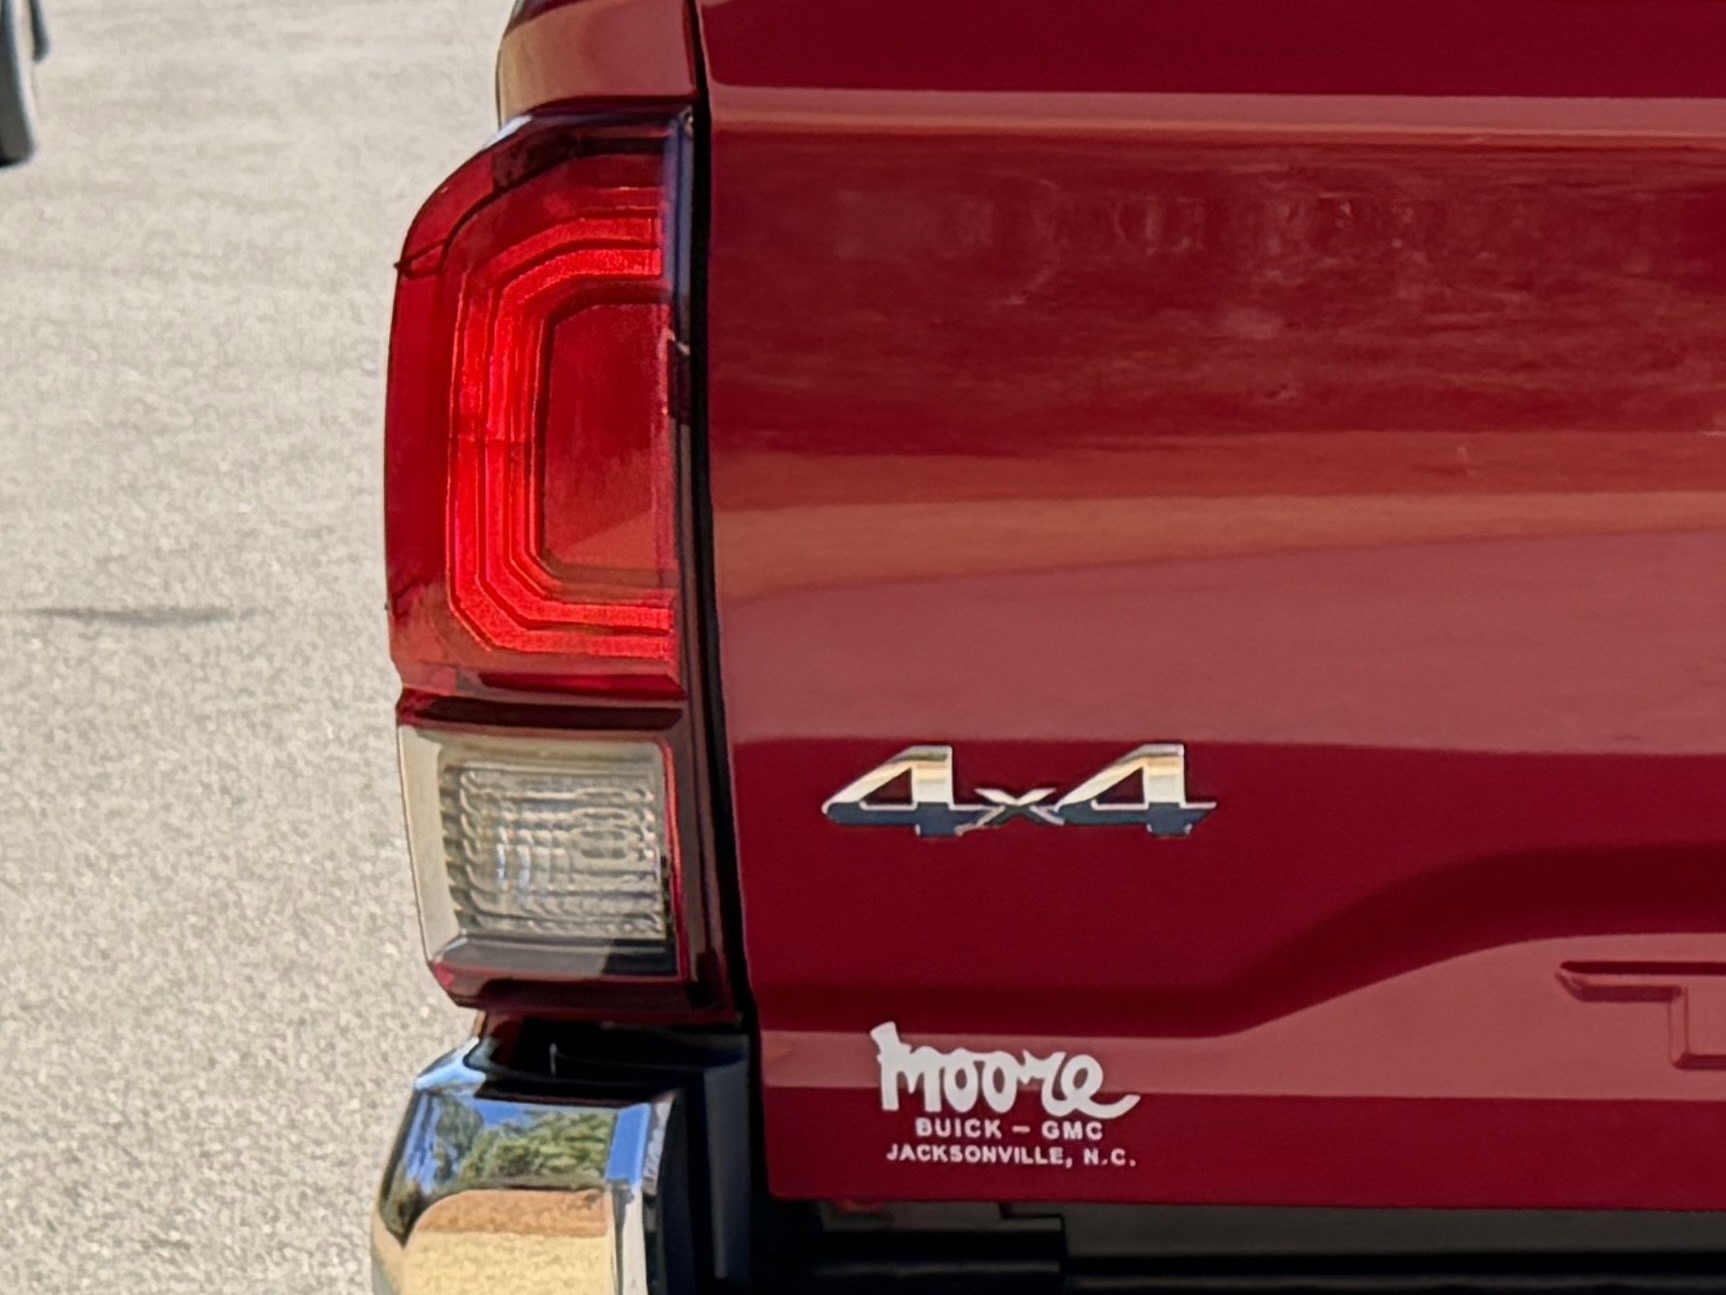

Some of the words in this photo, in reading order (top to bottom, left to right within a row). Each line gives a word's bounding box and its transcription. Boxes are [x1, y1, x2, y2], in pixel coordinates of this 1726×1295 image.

[915, 1117, 1002, 1138] BUICK
[1041, 1120, 1103, 1140] GMC
[886, 1143, 1073, 1168] JACKSONVILLE,
[1083, 1147, 1137, 1167] N.C.
